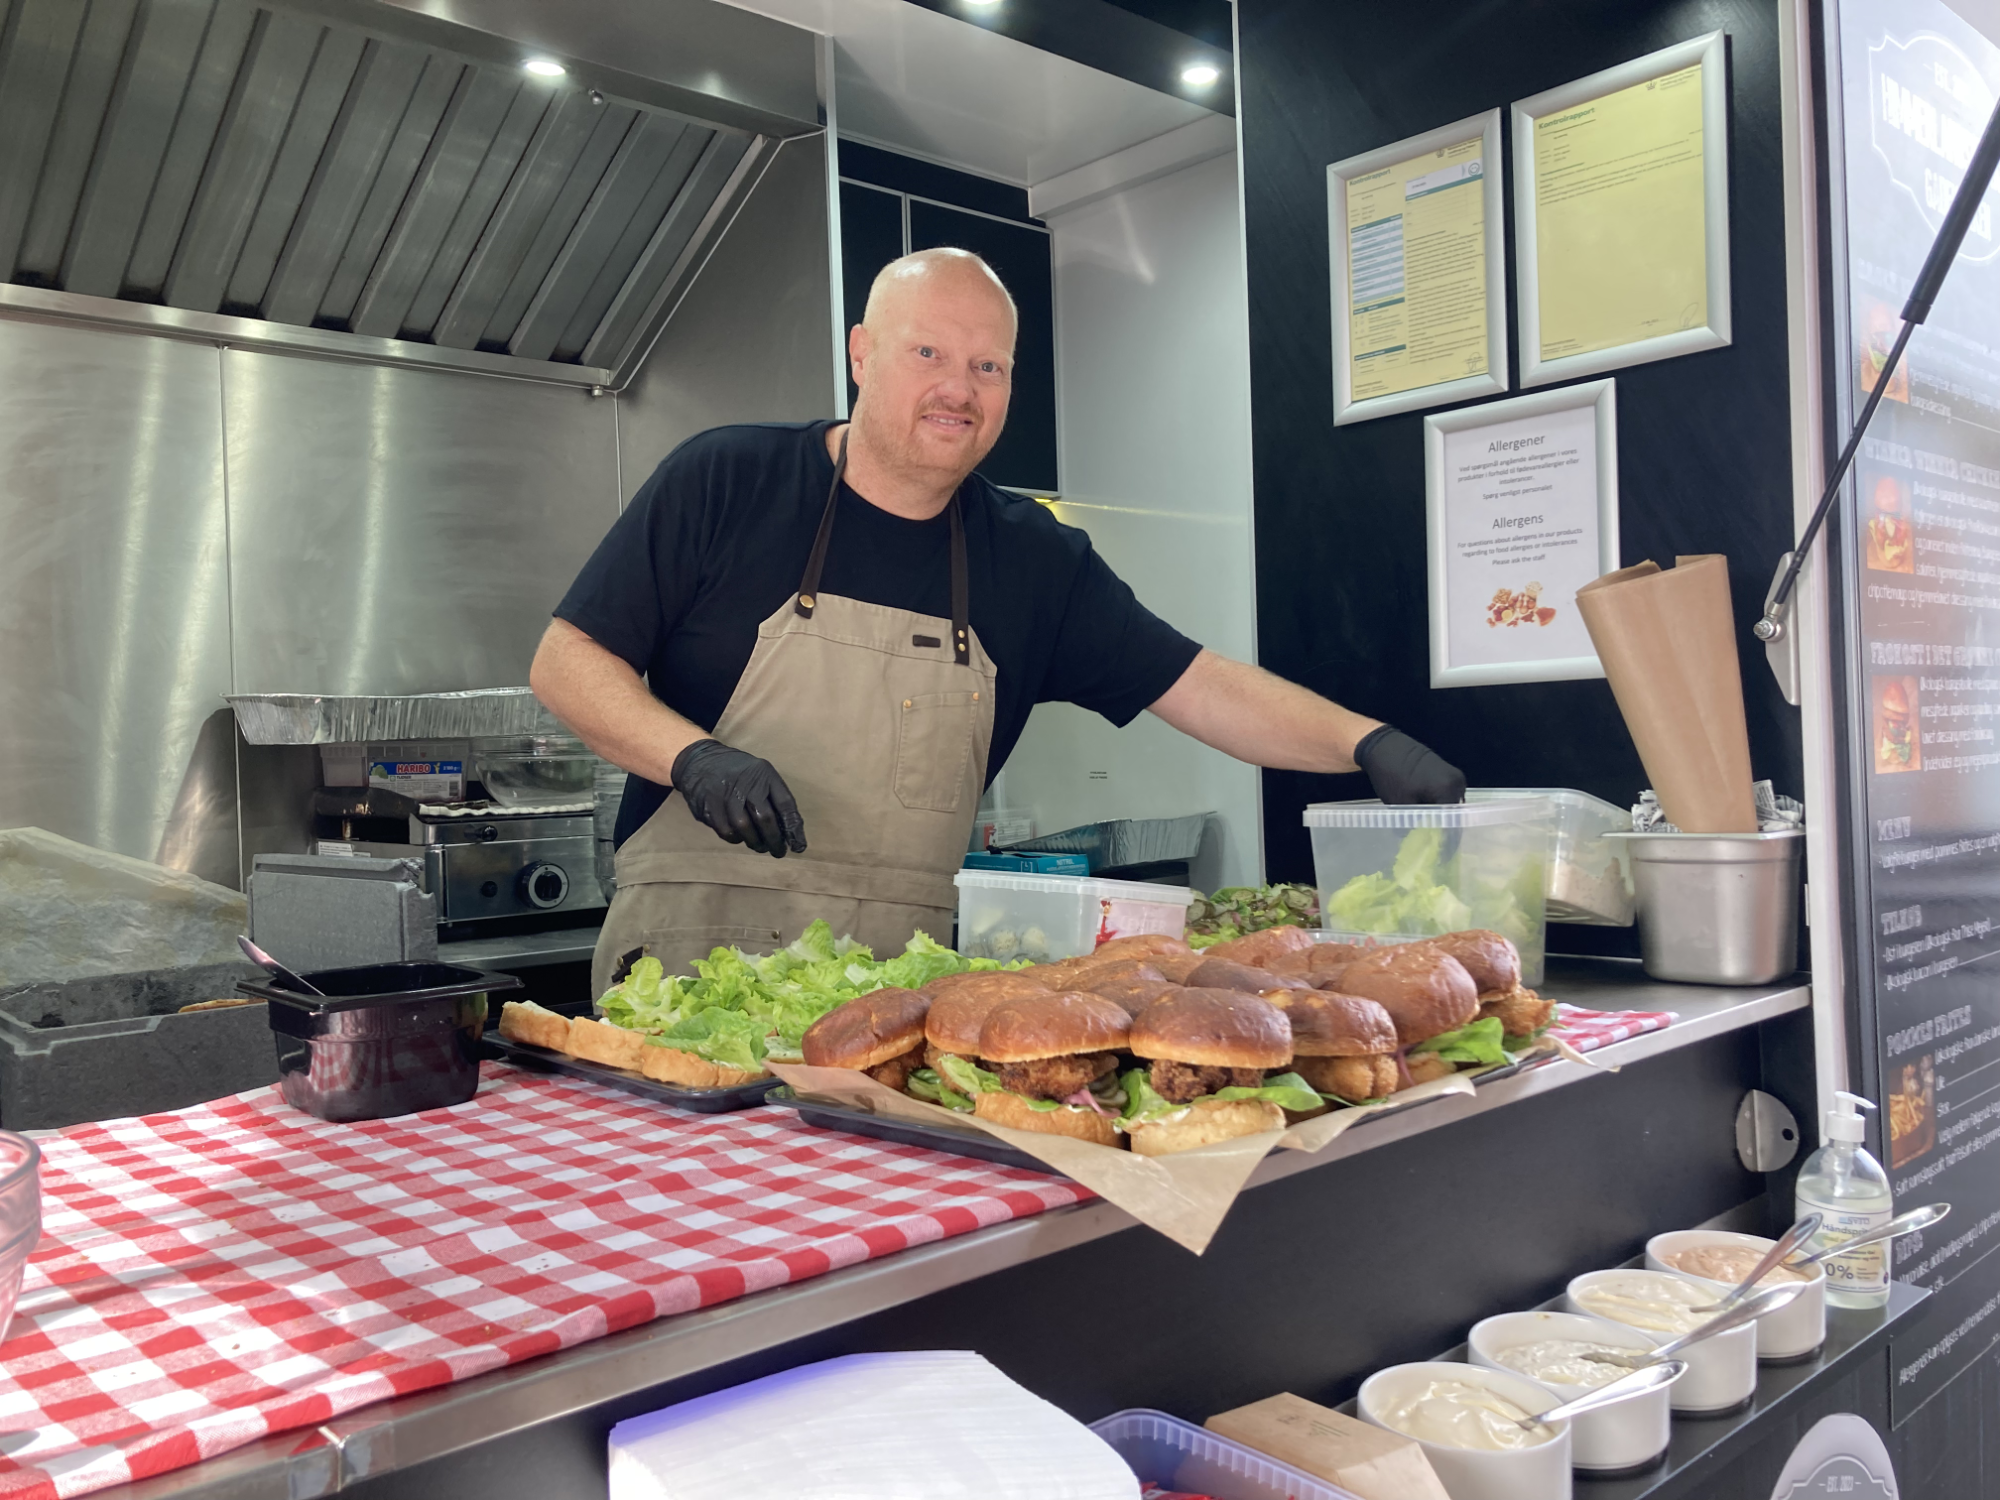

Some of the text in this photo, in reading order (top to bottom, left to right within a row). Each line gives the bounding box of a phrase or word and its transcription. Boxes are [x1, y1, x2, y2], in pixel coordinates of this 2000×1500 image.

[1488, 434, 1545, 453] Allergener
[1471, 460, 1498, 472] spørgsmål
[1500, 456, 1526, 467] angående
[1528, 451, 1556, 462] allergener
[1457, 472, 1484, 483] produkter
[1488, 469, 1508, 478] forhold
[1516, 460, 1565, 473] fødevareallergier
[1482, 484, 1553, 500] Spørg venligst personalet
[1492, 515, 1544, 529] Allergens
[1467, 539, 1493, 548] questions
[1494, 536, 1510, 544] about
[1511, 533, 1537, 542] allergens
[1556, 528, 1583, 537] products
[1462, 549, 1487, 558] regarding
[1510, 543, 1533, 552] allergies
[1542, 538, 1578, 547] intolerances
[1491, 558, 1510, 566] Please
[1532, 553, 1546, 561] staff
[396, 763, 431, 774] HARIBO
